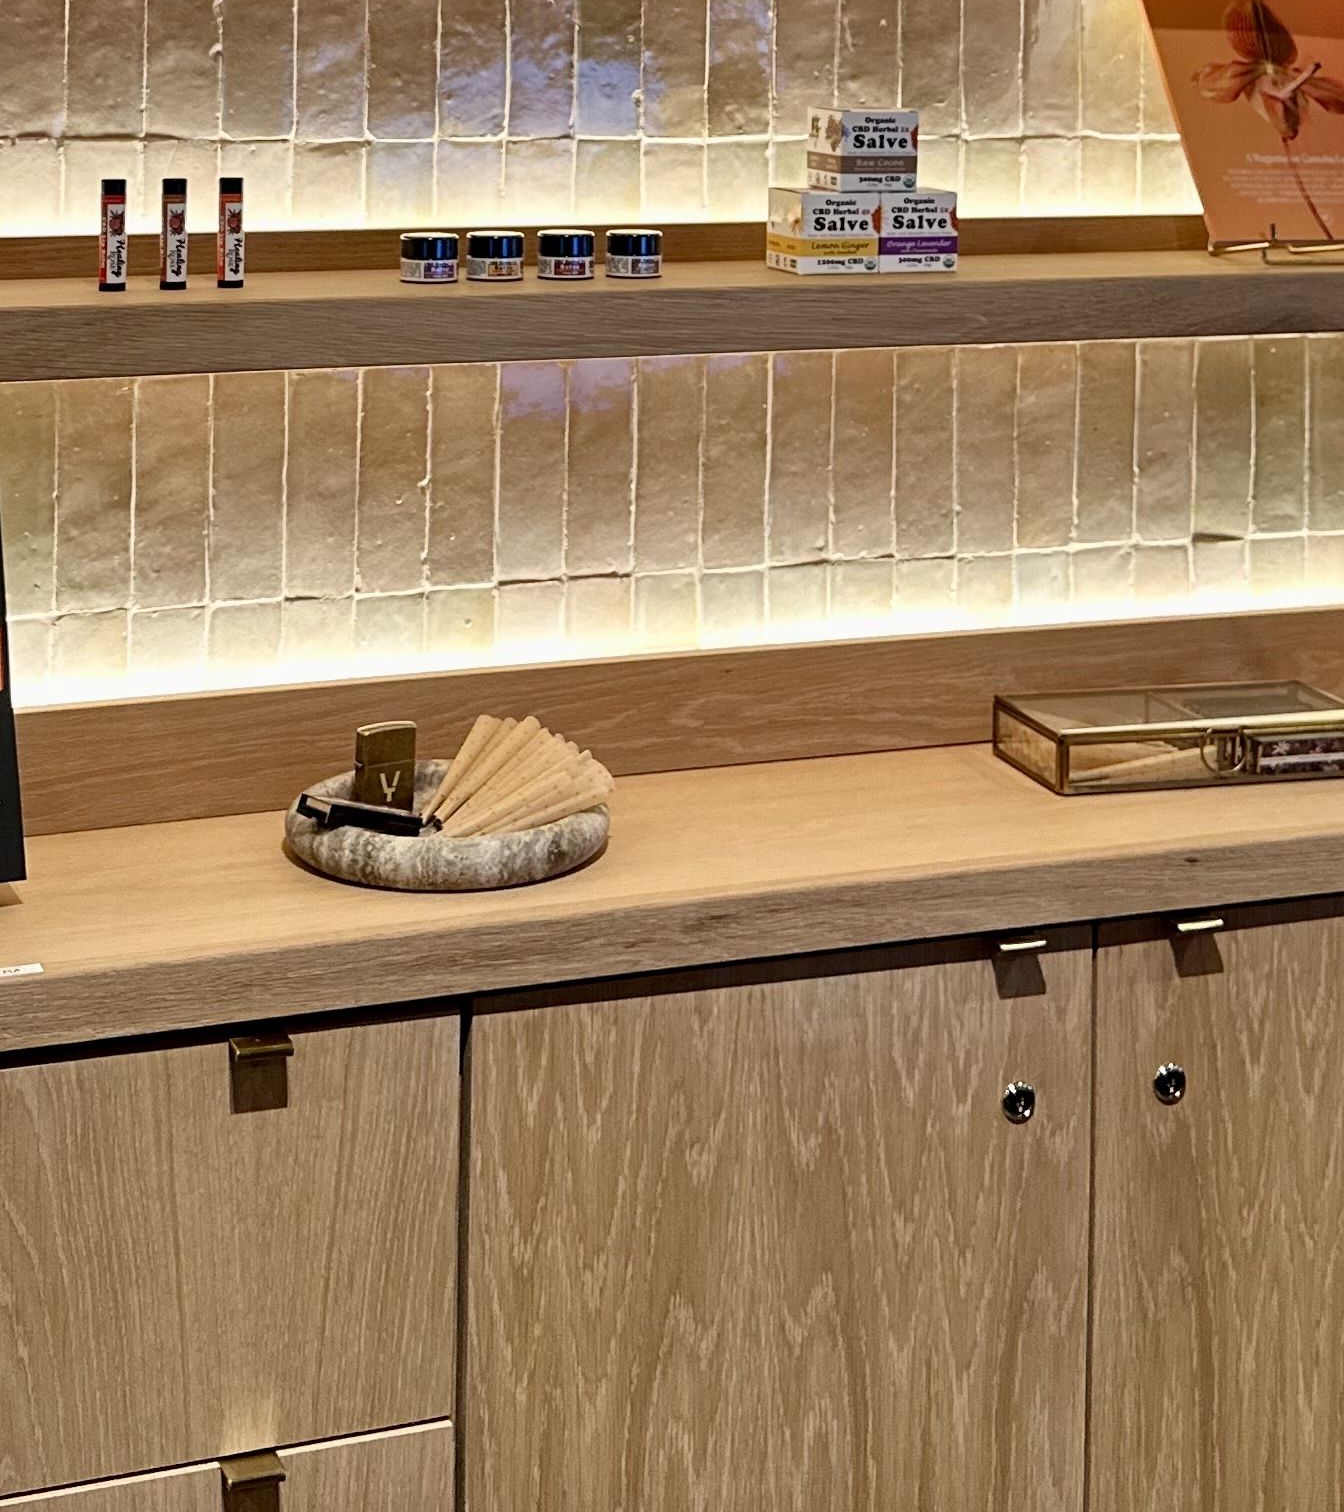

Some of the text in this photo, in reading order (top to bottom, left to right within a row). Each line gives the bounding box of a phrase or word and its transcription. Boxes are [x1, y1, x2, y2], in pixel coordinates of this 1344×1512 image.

[865, 116, 896, 124] Organic
[853, 134, 908, 149] Salve
[825, 199, 857, 207] Organic
[904, 197, 935, 205] Organic
[814, 216, 869, 231] Salve
[892, 215, 947, 229] Salve
[811, 241, 870, 252] Lemon Ginger
[111, 239, 126, 278] Healing
[172, 238, 185, 277] Healing
[230, 238, 243, 275] Healing
